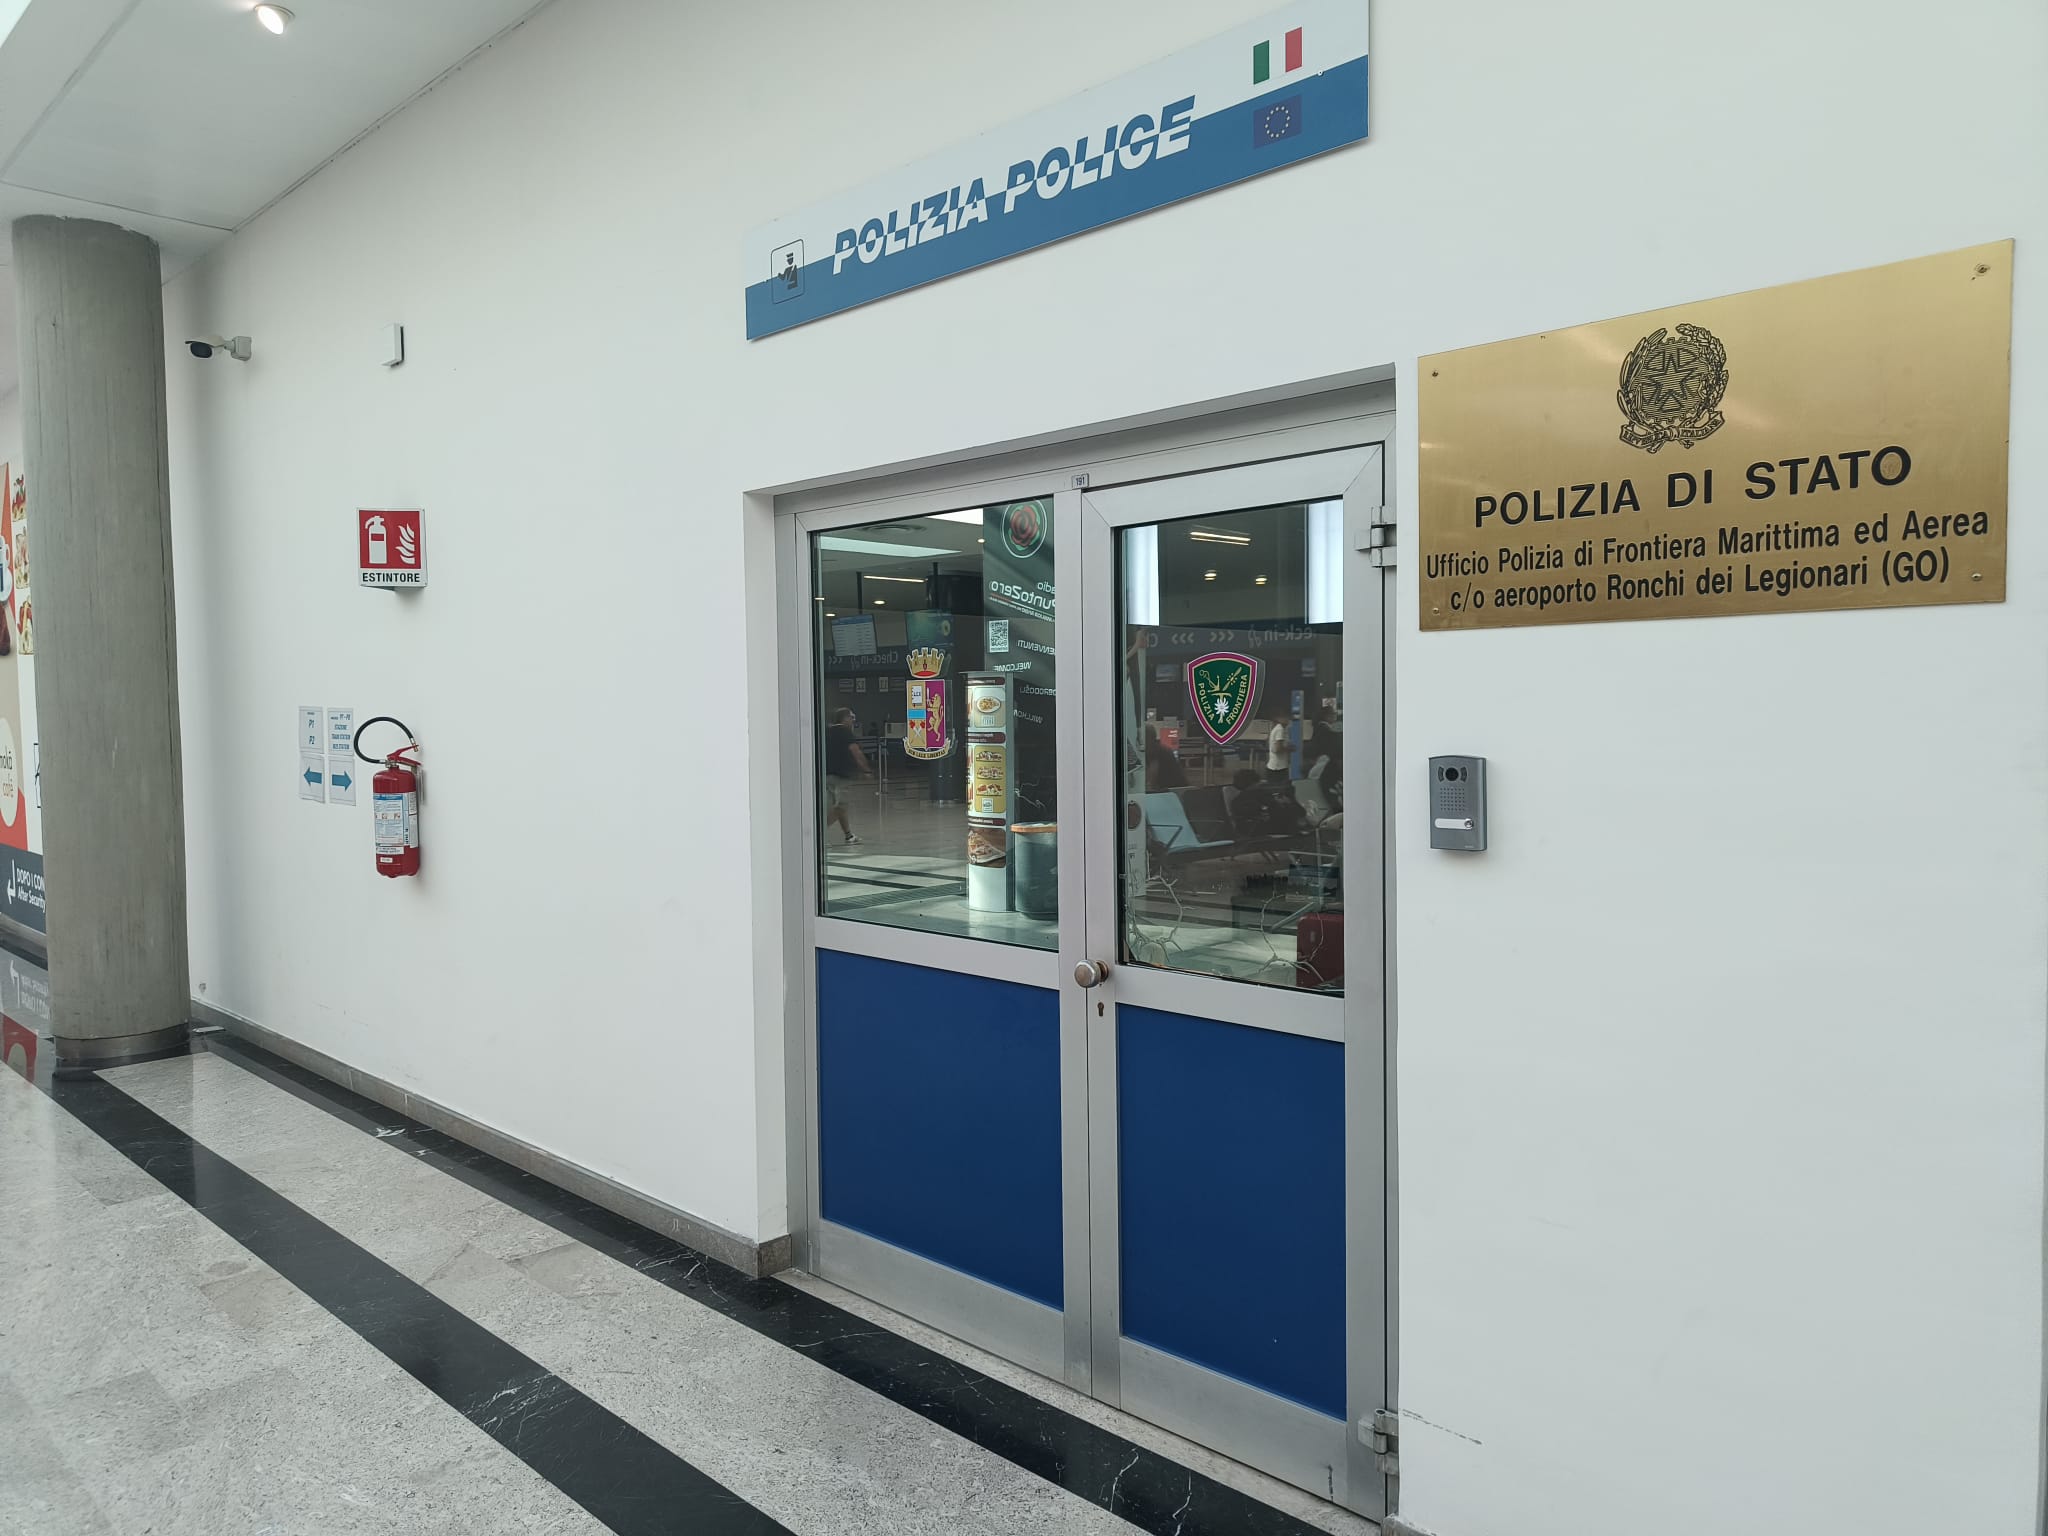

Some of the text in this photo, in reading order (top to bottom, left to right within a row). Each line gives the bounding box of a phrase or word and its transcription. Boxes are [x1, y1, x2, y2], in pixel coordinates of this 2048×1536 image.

[832, 95, 1196, 276] POLIZIA POLICE
[1475, 446, 1912, 528] POLIZIA DI STATO
[362, 572, 420, 583] ESTINTORE
[1426, 510, 1989, 580] Ufficio Polizia di Frontiera Marittima ed Aerea
[1450, 546, 1950, 613] c/o aeroporto Ronchi dei Legionari (GO)
[1198, 673, 1248, 725] POLIZIA FRONTIERA
